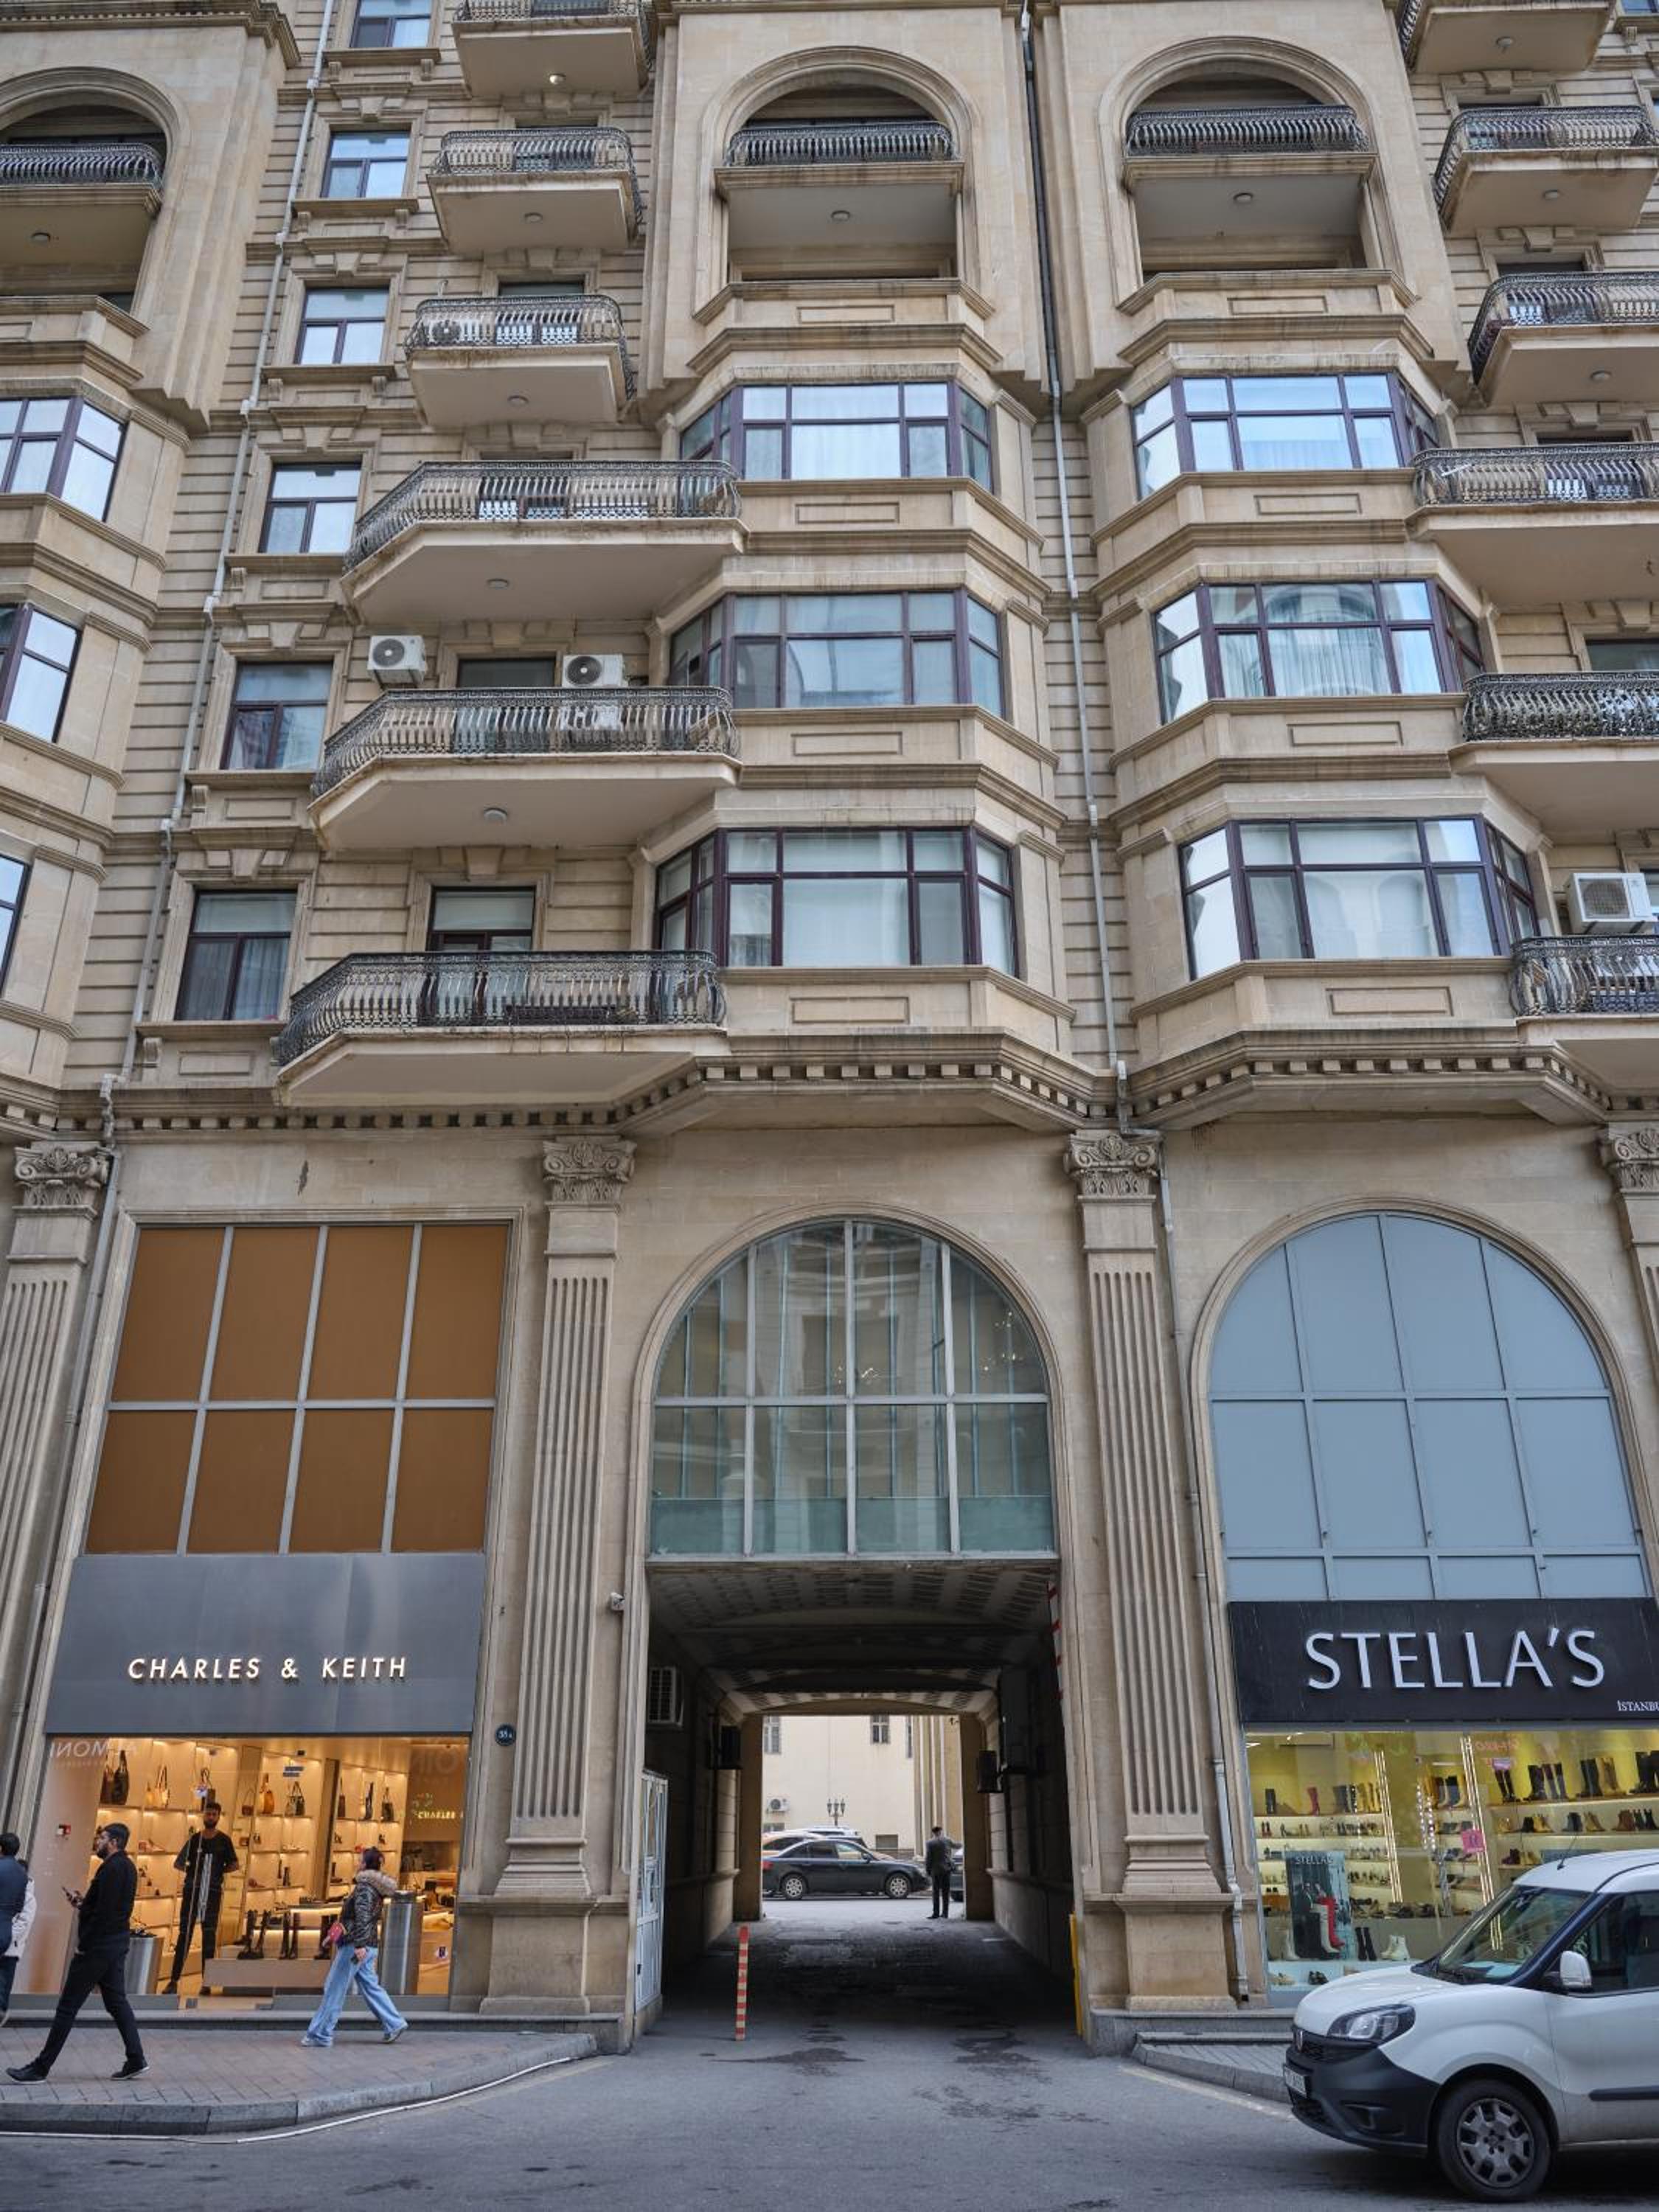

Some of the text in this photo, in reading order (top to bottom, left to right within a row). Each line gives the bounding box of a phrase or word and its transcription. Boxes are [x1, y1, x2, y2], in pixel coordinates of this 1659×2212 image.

[128, 1658, 406, 1680] CHARLES & KEITH
[1305, 1627, 1605, 1689] STELLA'S
